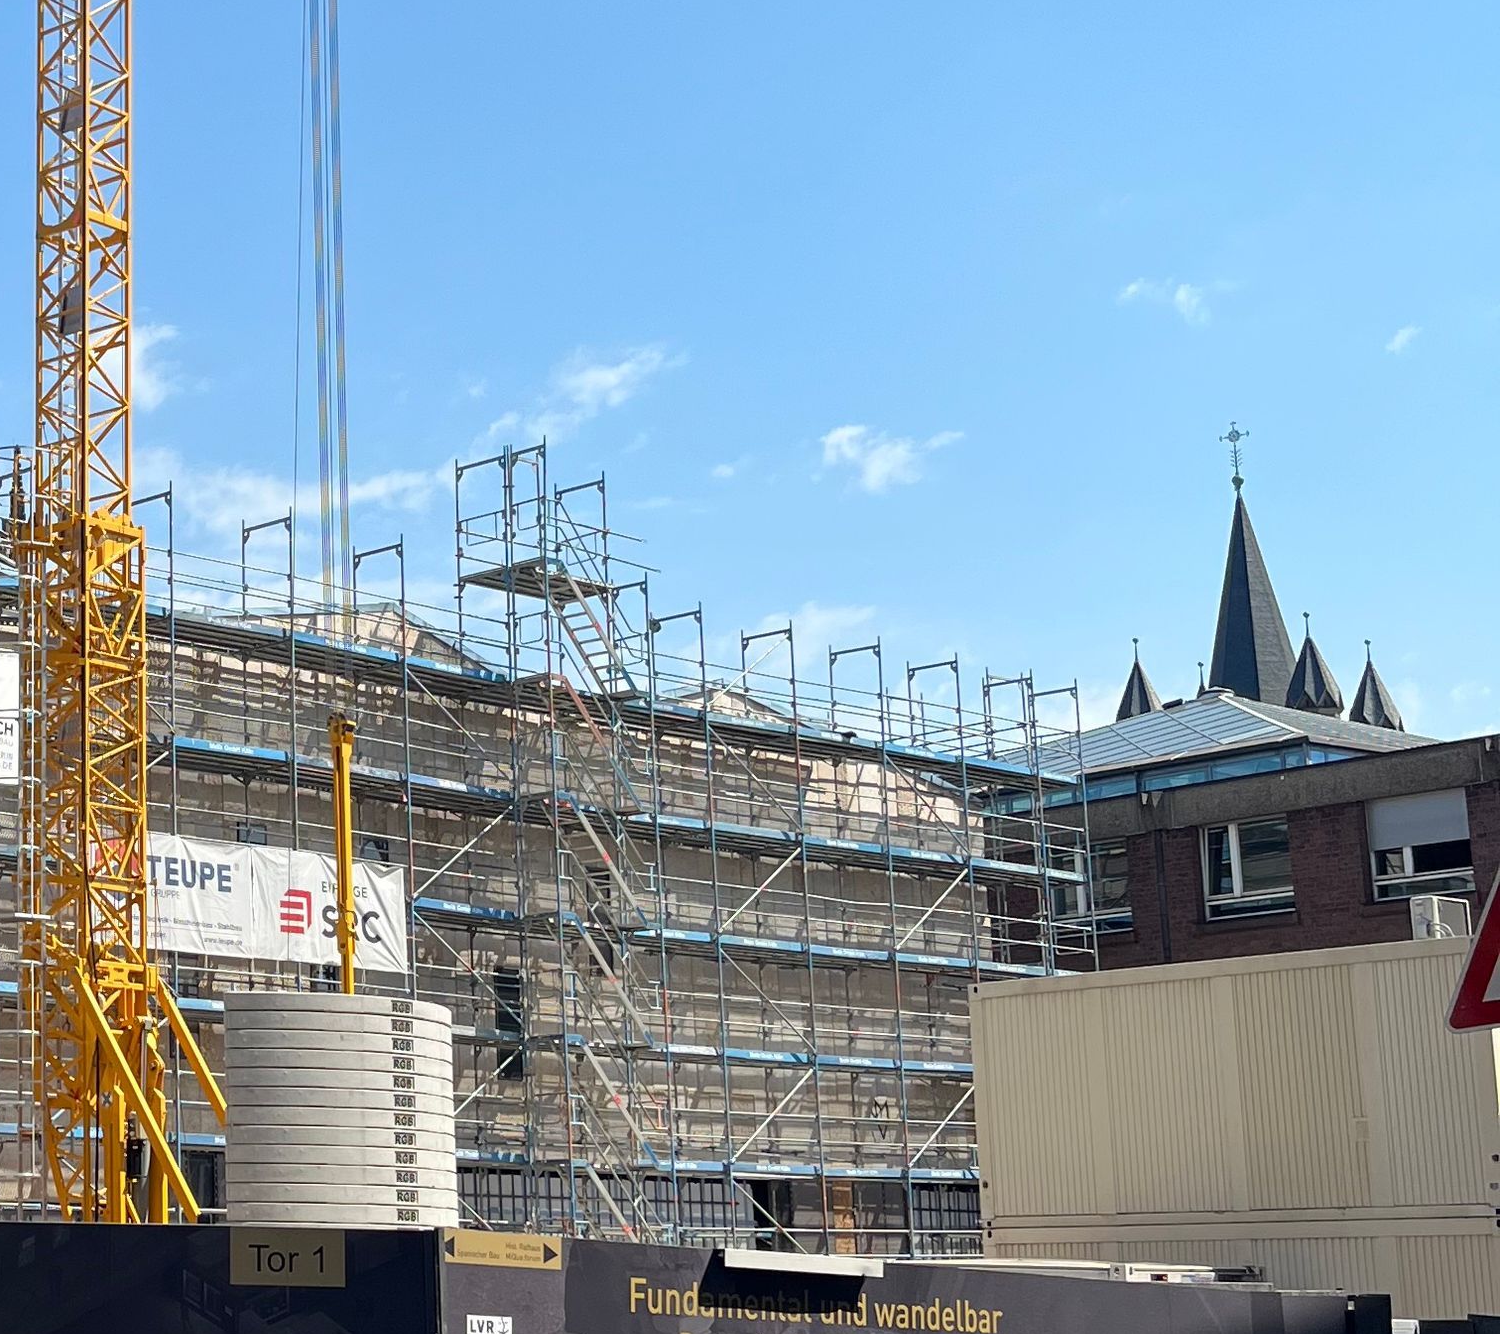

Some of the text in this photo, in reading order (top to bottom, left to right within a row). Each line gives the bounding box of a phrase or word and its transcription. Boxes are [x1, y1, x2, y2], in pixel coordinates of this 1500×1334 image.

[146, 855, 232, 893] TEUPE
[392, 1001, 411, 1014] RGB
[392, 1020, 411, 1033] RGB
[392, 1039, 412, 1052] RGB
[393, 1058, 413, 1071] RGB
[393, 1077, 413, 1090] RGB
[394, 1096, 413, 1109] RGB
[394, 1114, 414, 1127] RGB
[395, 1133, 415, 1146] RGB
[395, 1152, 415, 1165] RGB
[396, 1171, 416, 1184] RGB
[396, 1191, 417, 1203] RGB
[397, 1209, 417, 1222] RGB
[248, 1243, 325, 1274] Tor 1
[630, 1276, 1003, 1334] Fundamental und wandelbar
[469, 1319, 495, 1334] LVR
